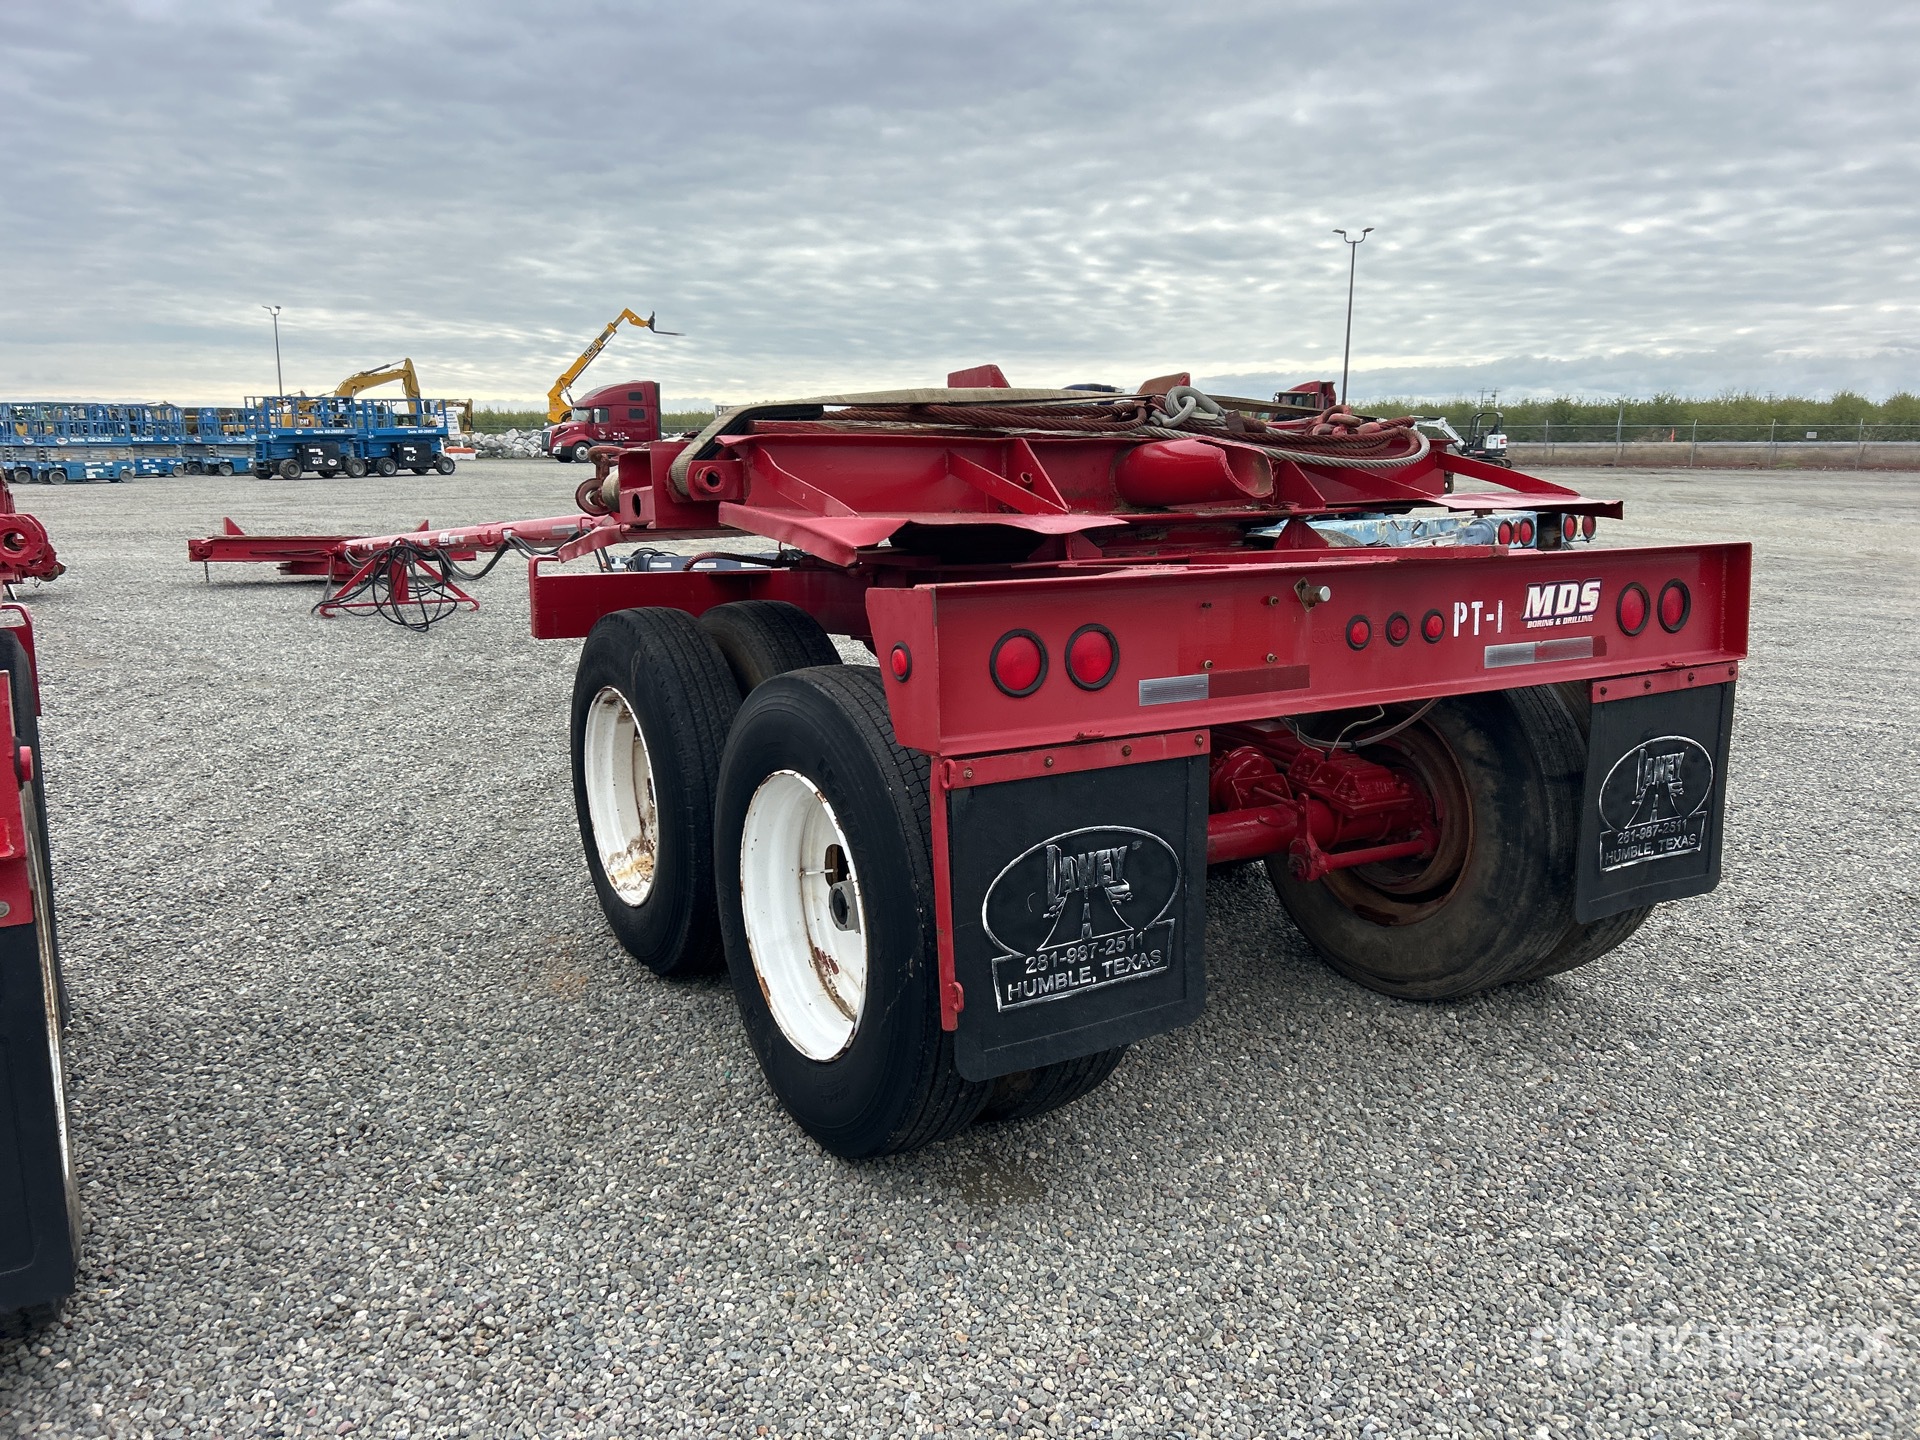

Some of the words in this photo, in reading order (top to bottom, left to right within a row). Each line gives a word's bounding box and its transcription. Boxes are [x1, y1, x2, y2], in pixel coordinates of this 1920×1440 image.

[583, 340, 599, 359] JCB
[1522, 579, 1602, 620] MDS
[1526, 618, 1554, 629] BORING
[1555, 617, 1562, 626] &
[1562, 614, 1594, 625] DRILLING
[1617, 818, 1687, 845] 281-987-2511
[1604, 841, 1655, 866] HUMBLE,
[1658, 833, 1697, 852] TEXAS
[1025, 931, 1143, 975] 281-987-2511
[1007, 965, 1097, 1001] HUMBLE,
[1101, 949, 1162, 978] TEXAS
